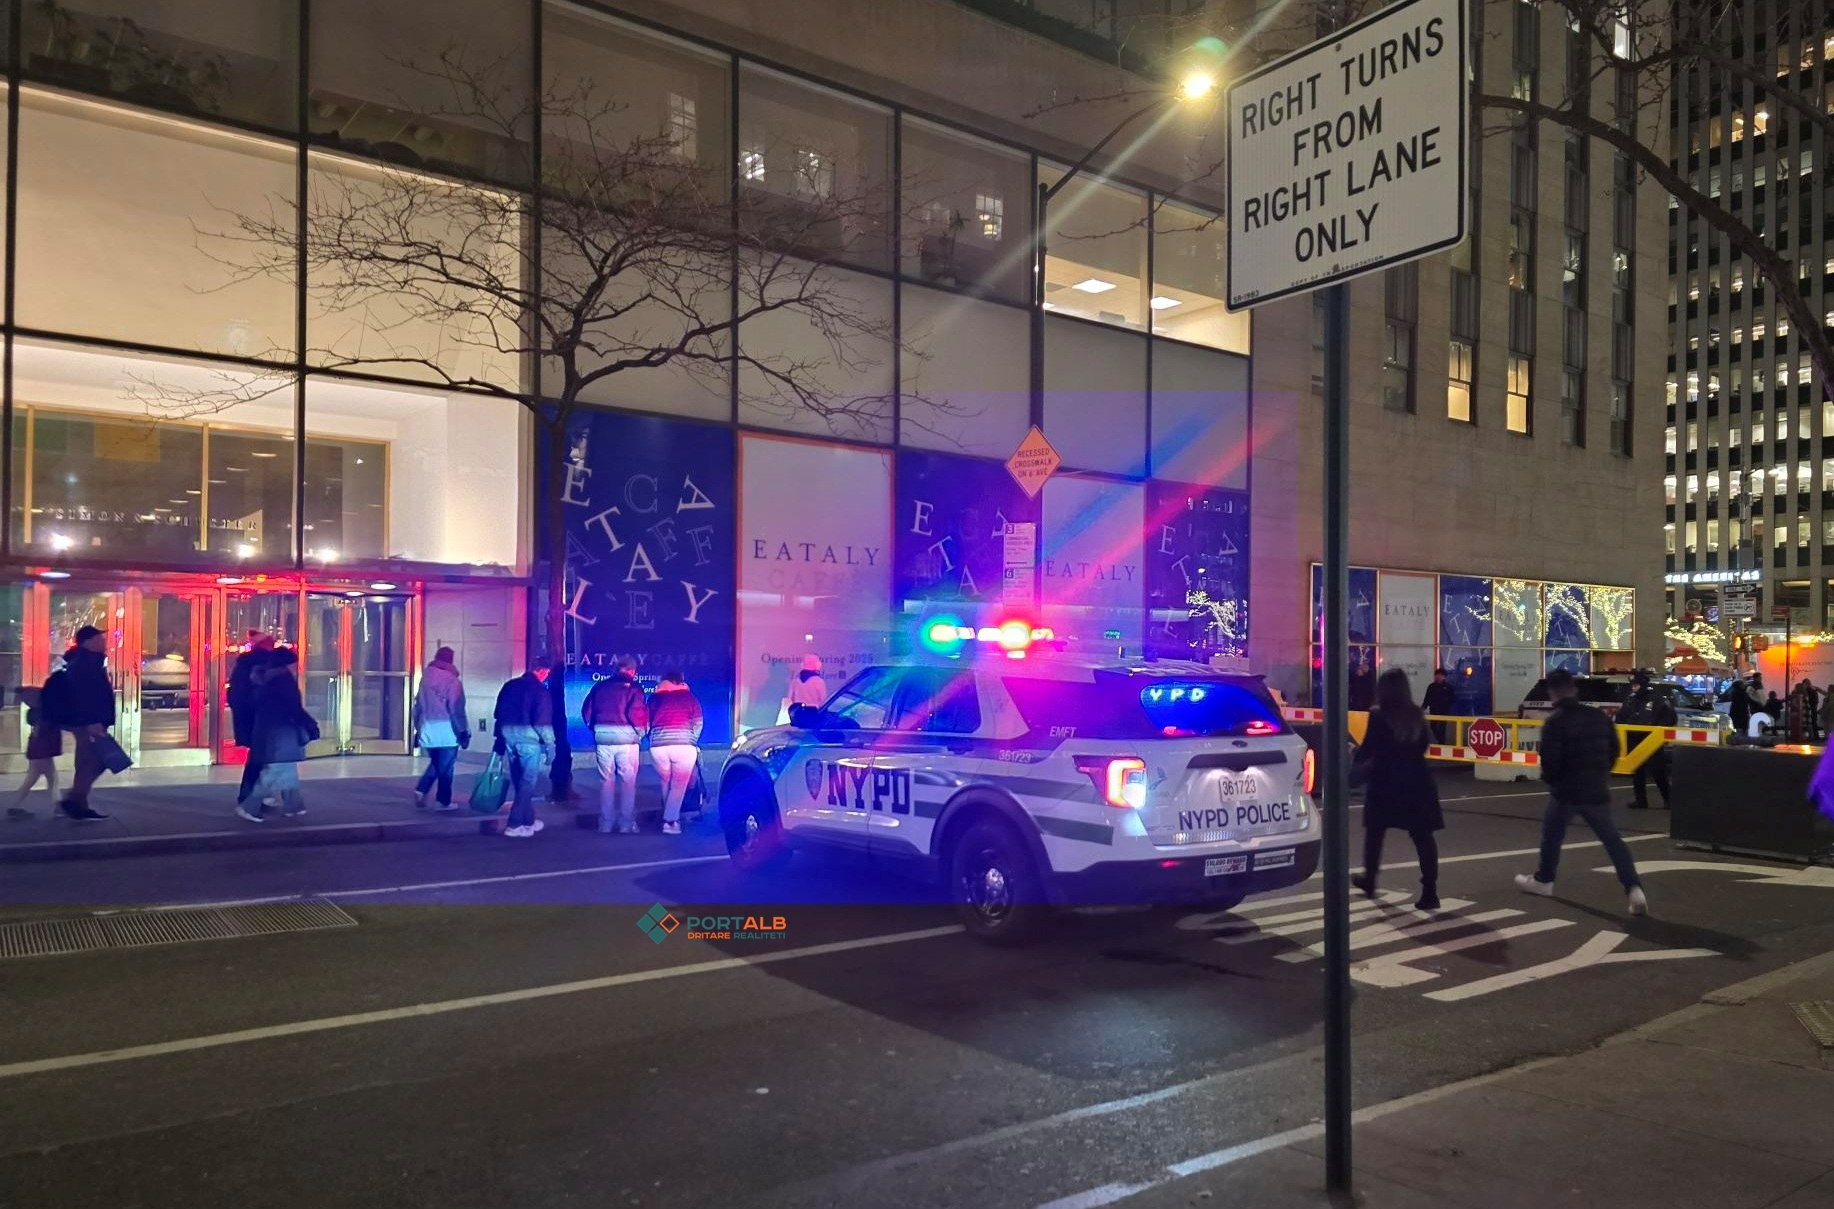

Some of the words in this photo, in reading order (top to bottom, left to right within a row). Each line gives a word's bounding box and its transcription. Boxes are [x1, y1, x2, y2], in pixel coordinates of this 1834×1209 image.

[1242, 73, 1321, 139] RIGHT
[1340, 17, 1444, 95] TURNS
[1293, 97, 1382, 166] FROM
[1244, 169, 1331, 232] RIGHT
[1347, 126, 1441, 197] LANE
[1295, 203, 1379, 262] ONLY
[1017, 448, 1050, 458] RECESSED
[1014, 459, 1052, 469] CROSSWALK
[753, 539, 880, 566] EATALY
[1046, 560, 1136, 581] EATALY
[1384, 604, 1430, 617] EATALY
[567, 653, 648, 666] EATAY
[849, 653, 874, 664] 2025
[1470, 730, 1502, 745] STOP
[827, 763, 910, 815] NYPD
[1222, 778, 1257, 796] 361723
[1178, 808, 1229, 831] NYPD
[1237, 802, 1290, 826] POLICE
